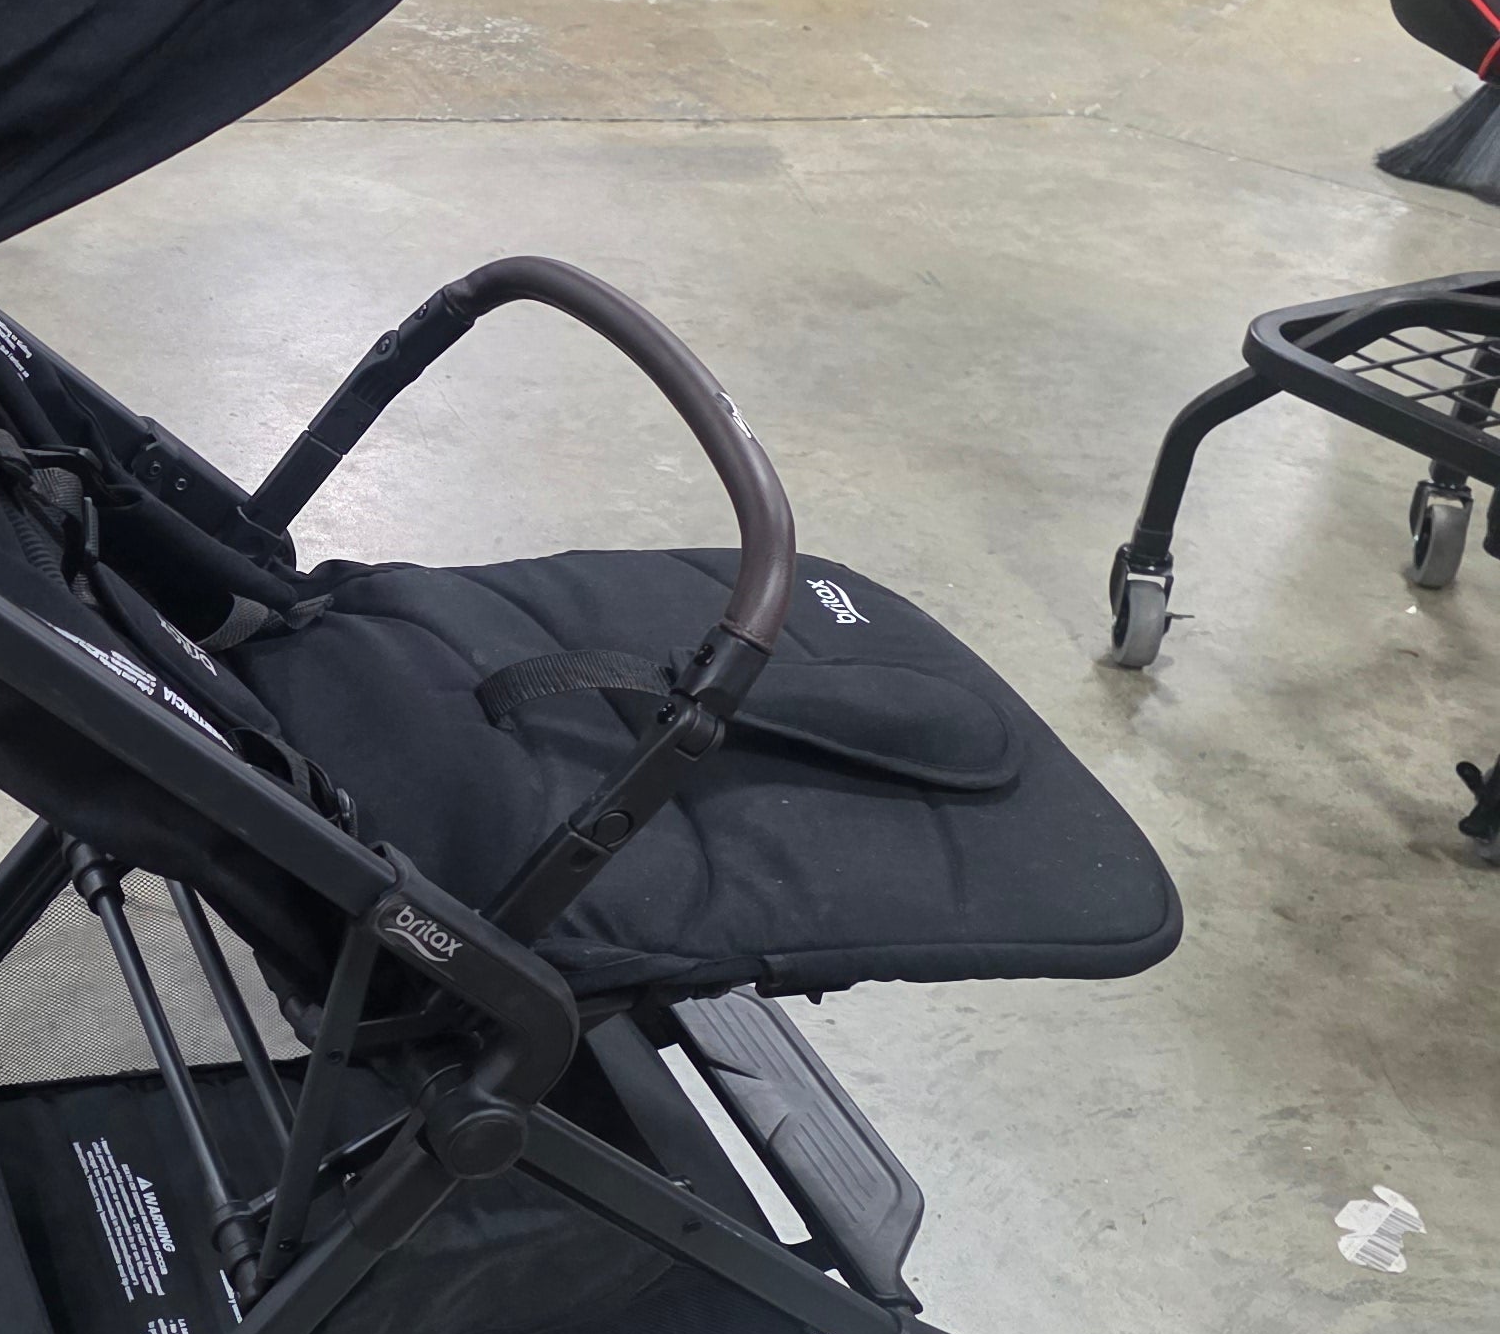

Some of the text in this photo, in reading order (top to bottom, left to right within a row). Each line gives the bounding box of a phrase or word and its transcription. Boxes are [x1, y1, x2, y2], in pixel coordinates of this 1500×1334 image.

[806, 579, 857, 625] britax
[395, 905, 464, 958] britax
[143, 1192, 176, 1253] WARNING
